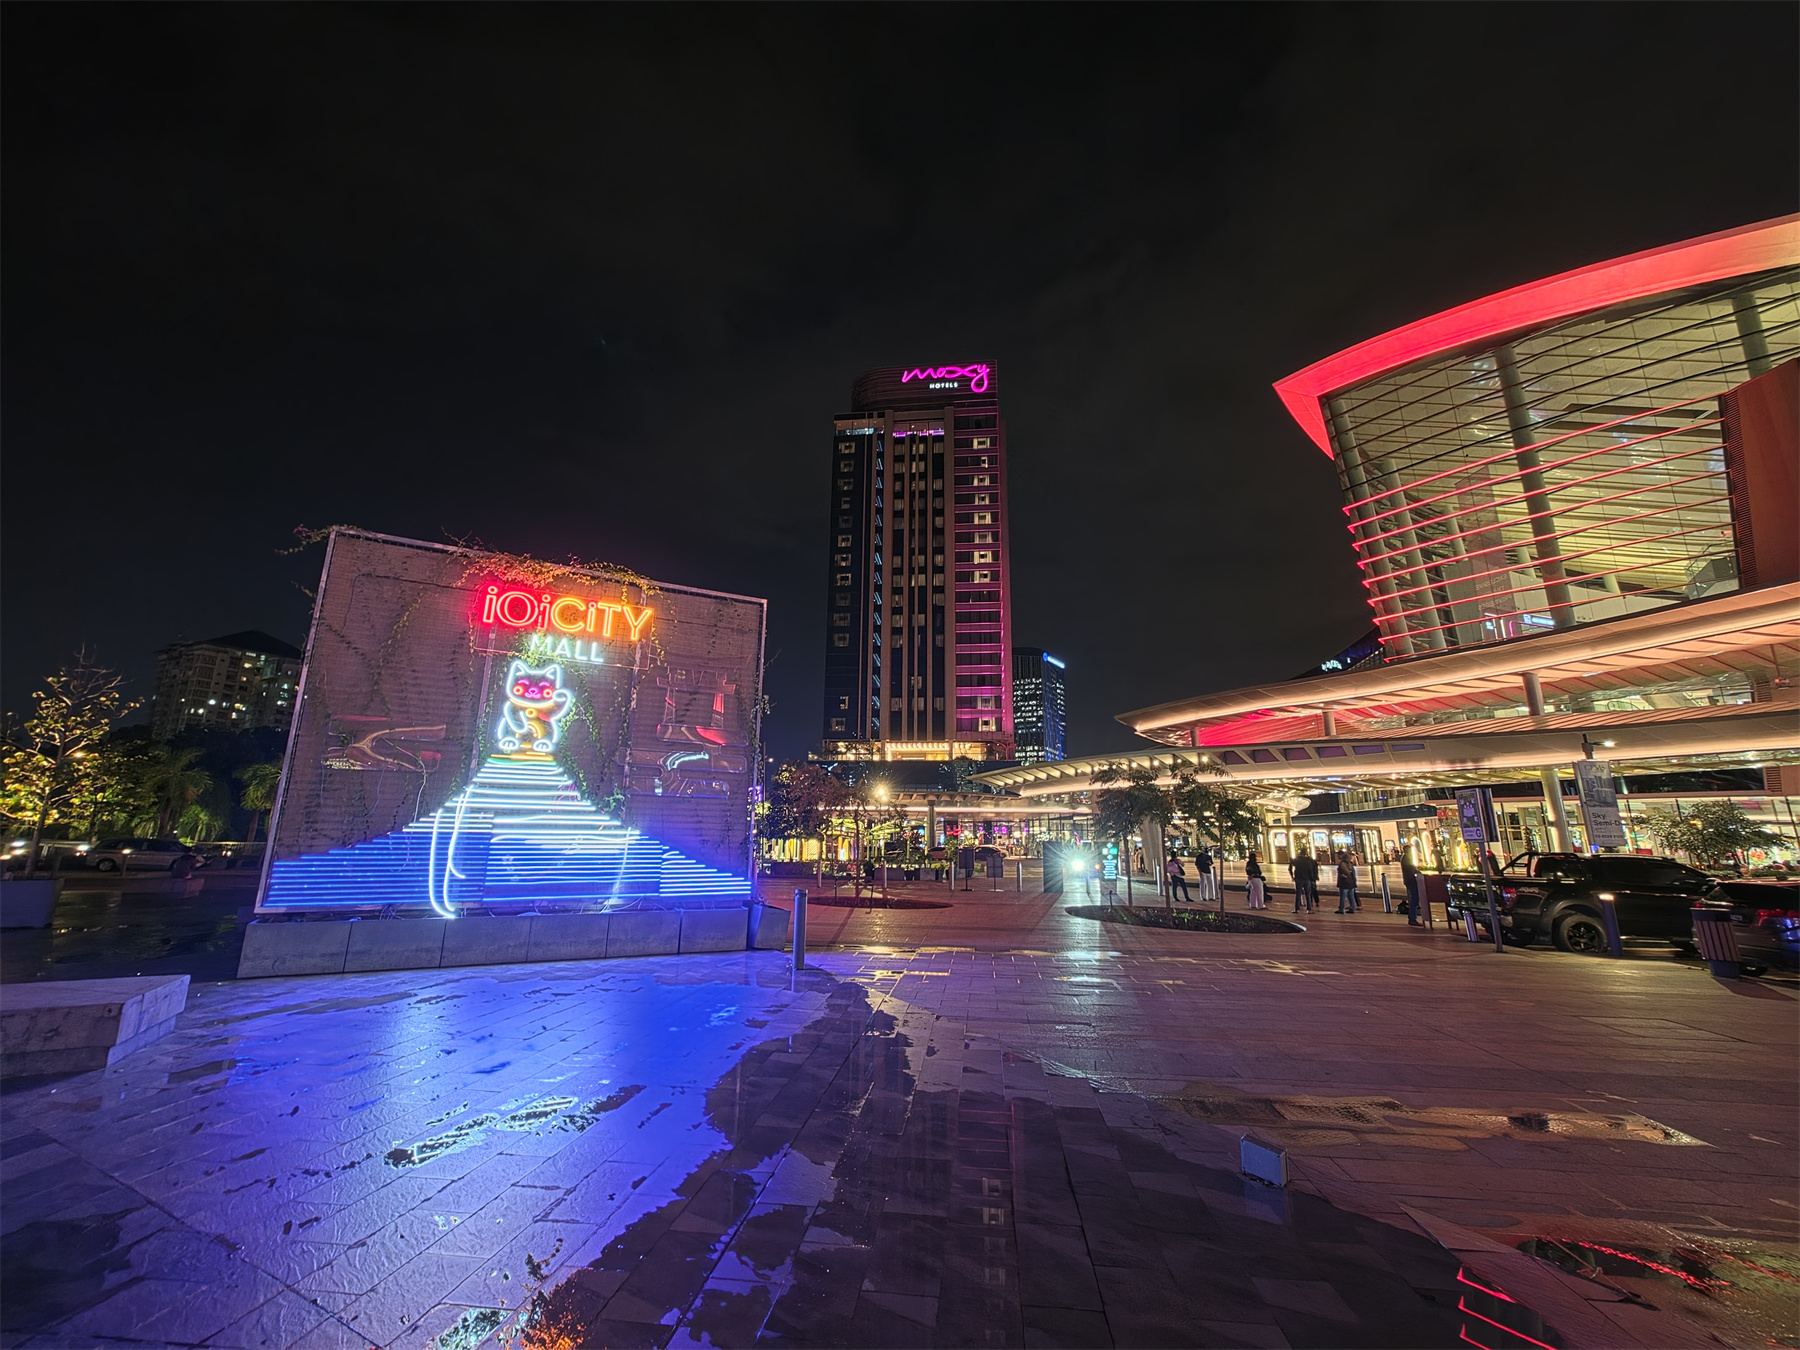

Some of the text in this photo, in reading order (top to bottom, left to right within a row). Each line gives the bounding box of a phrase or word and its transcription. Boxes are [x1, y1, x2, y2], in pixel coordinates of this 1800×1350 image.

[901, 364, 990, 393] moxy
[929, 381, 959, 389] HOTELS
[529, 632, 605, 664] MALL
